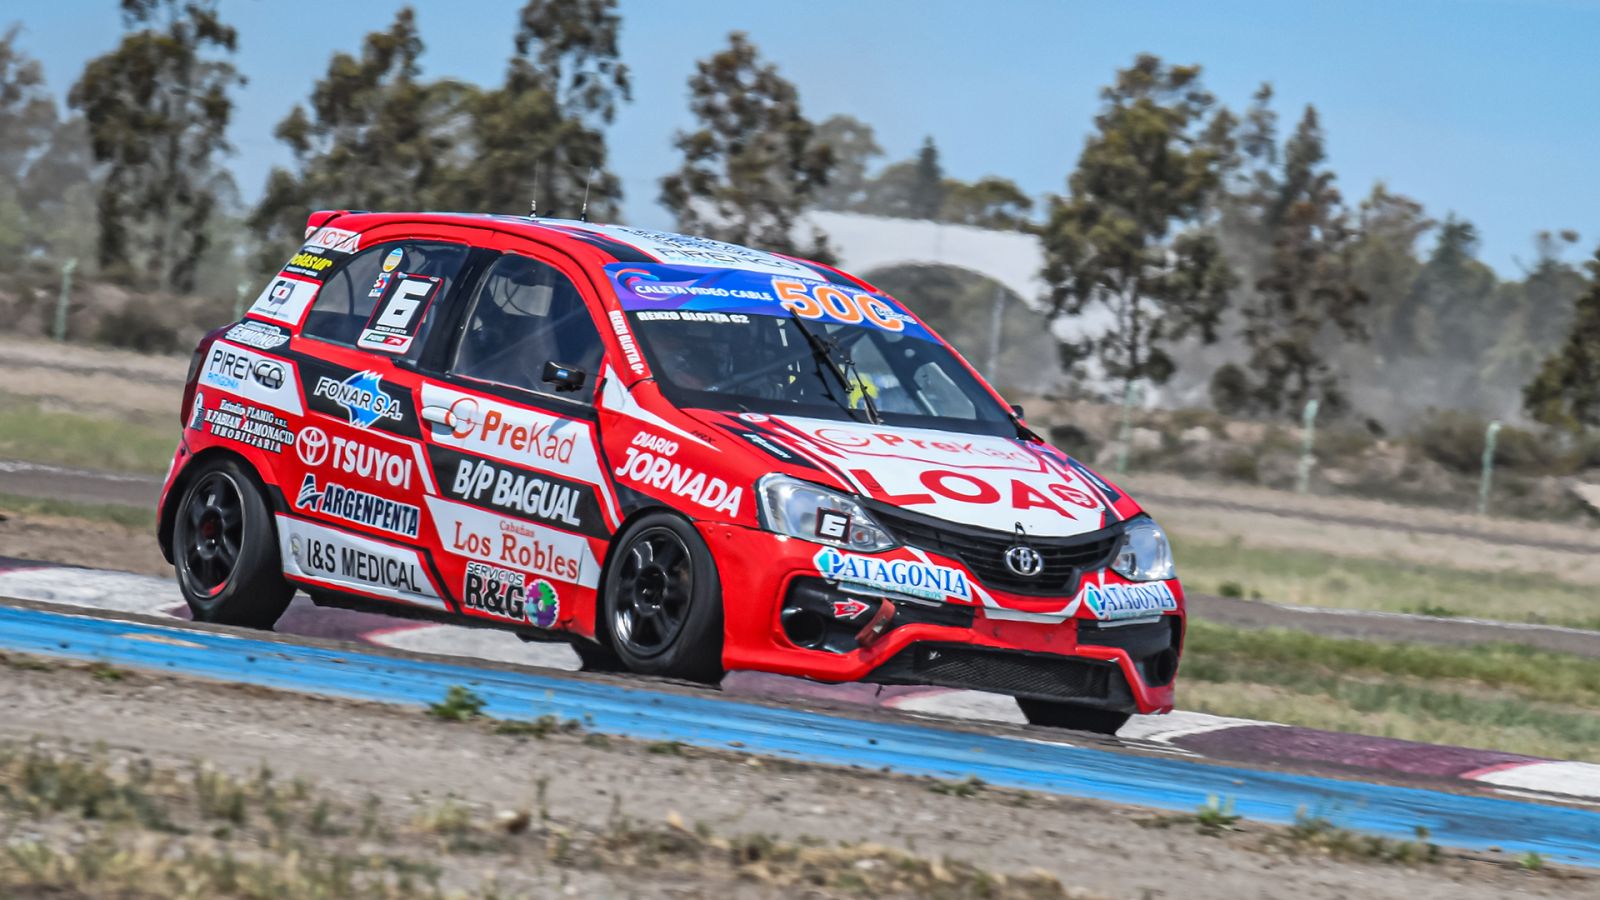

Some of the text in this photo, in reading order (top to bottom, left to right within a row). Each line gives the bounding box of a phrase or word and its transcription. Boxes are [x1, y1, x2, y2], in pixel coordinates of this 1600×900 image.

[377, 280, 433, 328] 6
[634, 284, 774, 301] CALETA VIDEO CABLE
[314, 377, 403, 420] FONAR S.A.
[241, 420, 294, 445] ALMONACID
[480, 410, 577, 464] PreKad
[632, 431, 679, 457] DIARIO
[332, 436, 412, 490] TSUYOI
[615, 447, 743, 517] JORNADA
[321, 483, 420, 538] ARGENPENTA
[452, 459, 581, 527] B/P BAGUAL
[453, 521, 577, 579] Los Robles
[820, 514, 848, 538] 6
[307, 538, 422, 592] I&S MEDICAL
[466, 562, 524, 586] SERVICIOS
[829, 550, 969, 597] PATAGONIA
[465, 572, 525, 621] R&G
